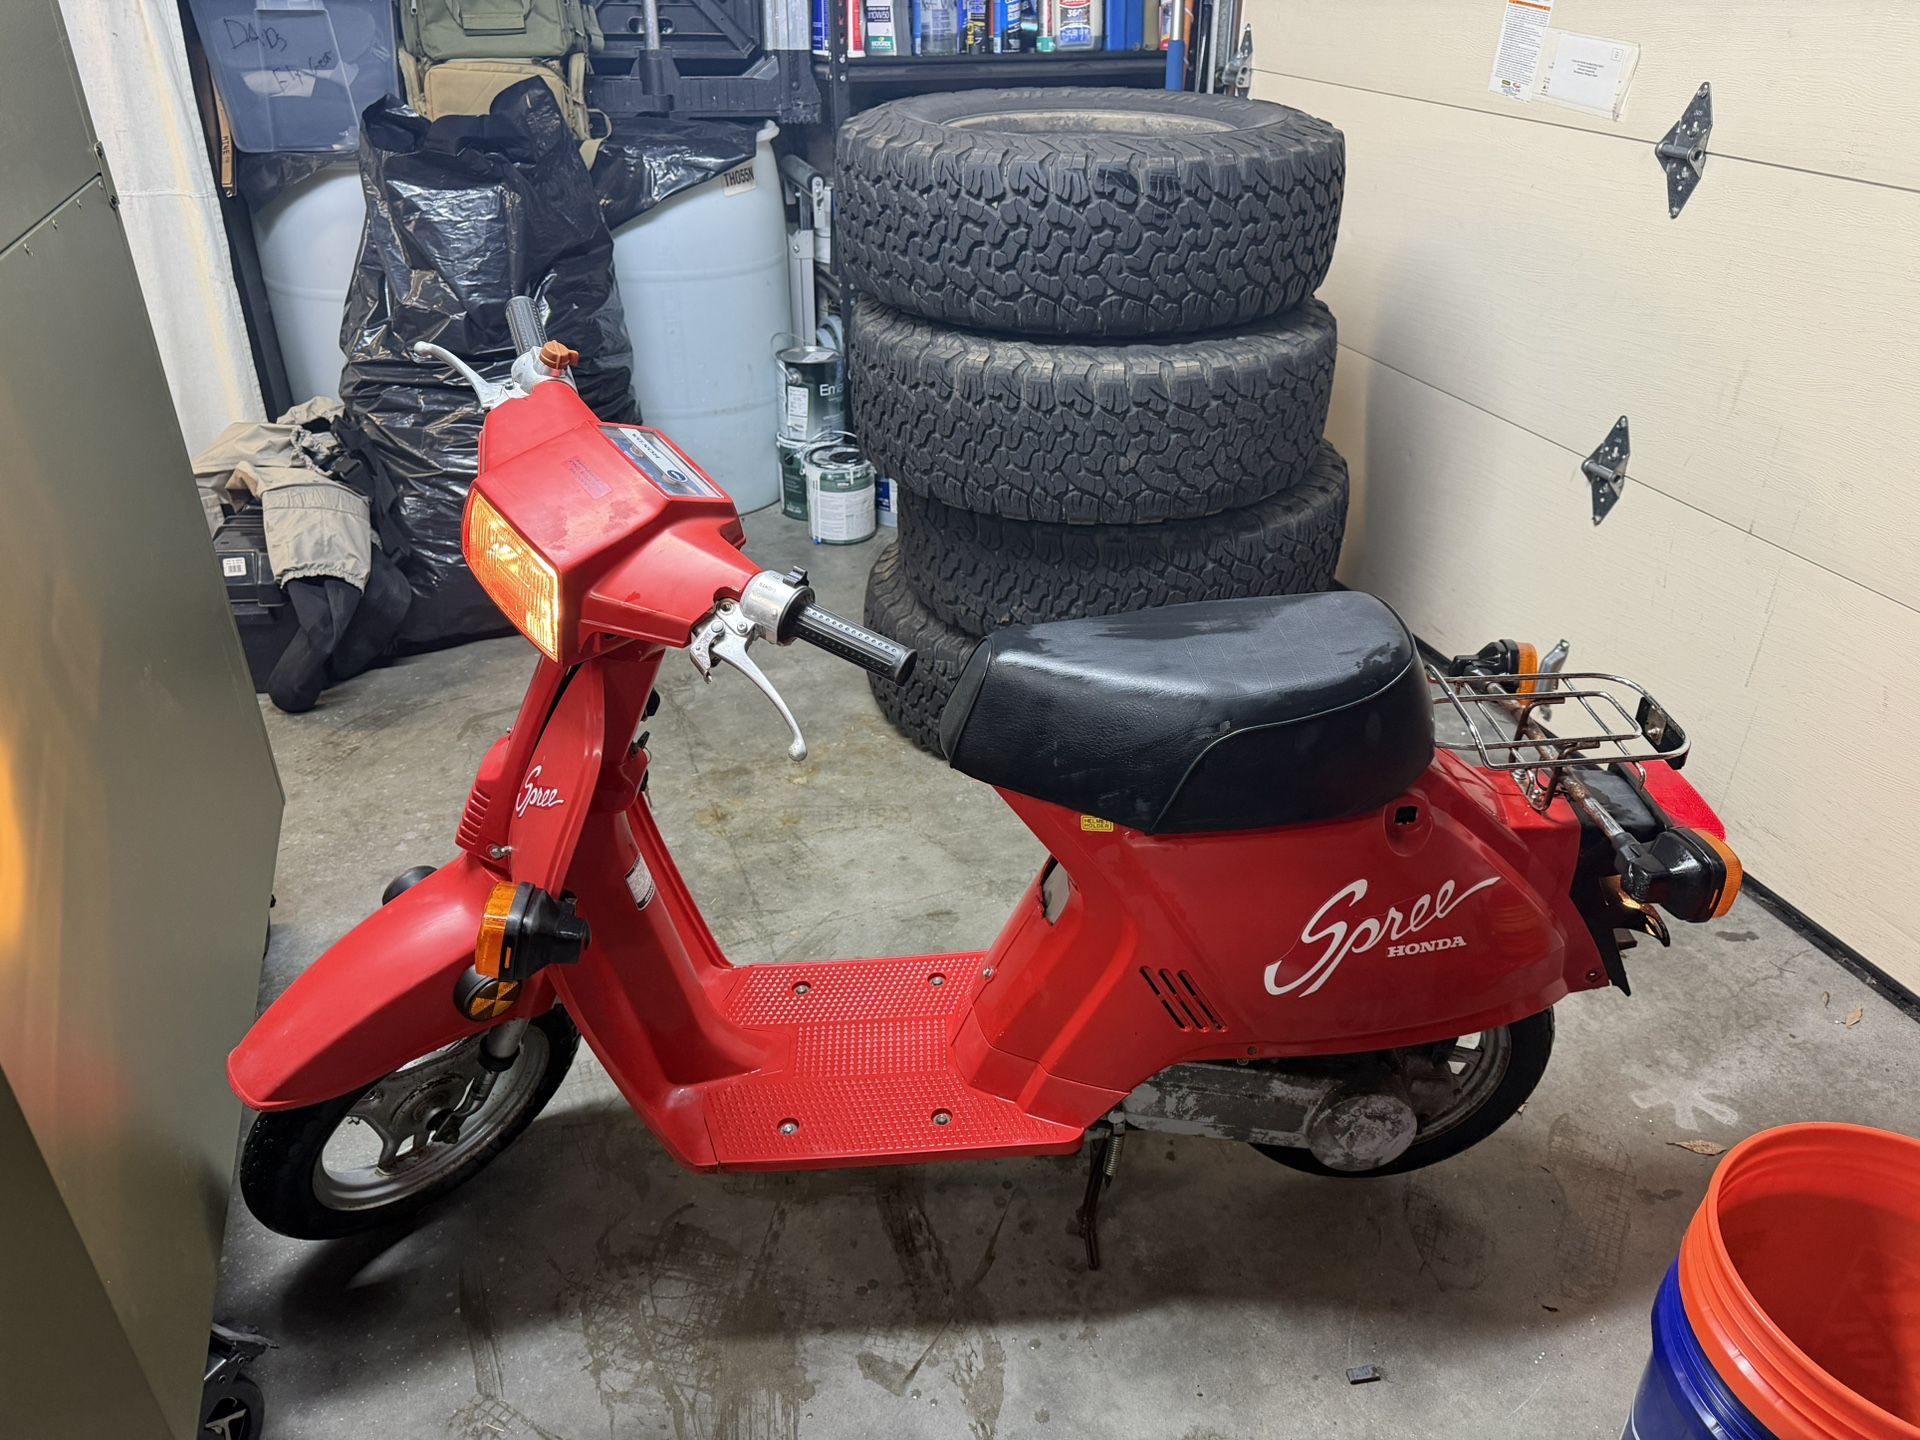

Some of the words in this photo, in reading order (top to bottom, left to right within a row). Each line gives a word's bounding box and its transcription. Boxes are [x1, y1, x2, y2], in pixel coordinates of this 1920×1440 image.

[515, 765, 564, 818] Spree
[1263, 876, 1501, 998] Spree
[1387, 936, 1467, 958] HONDA
